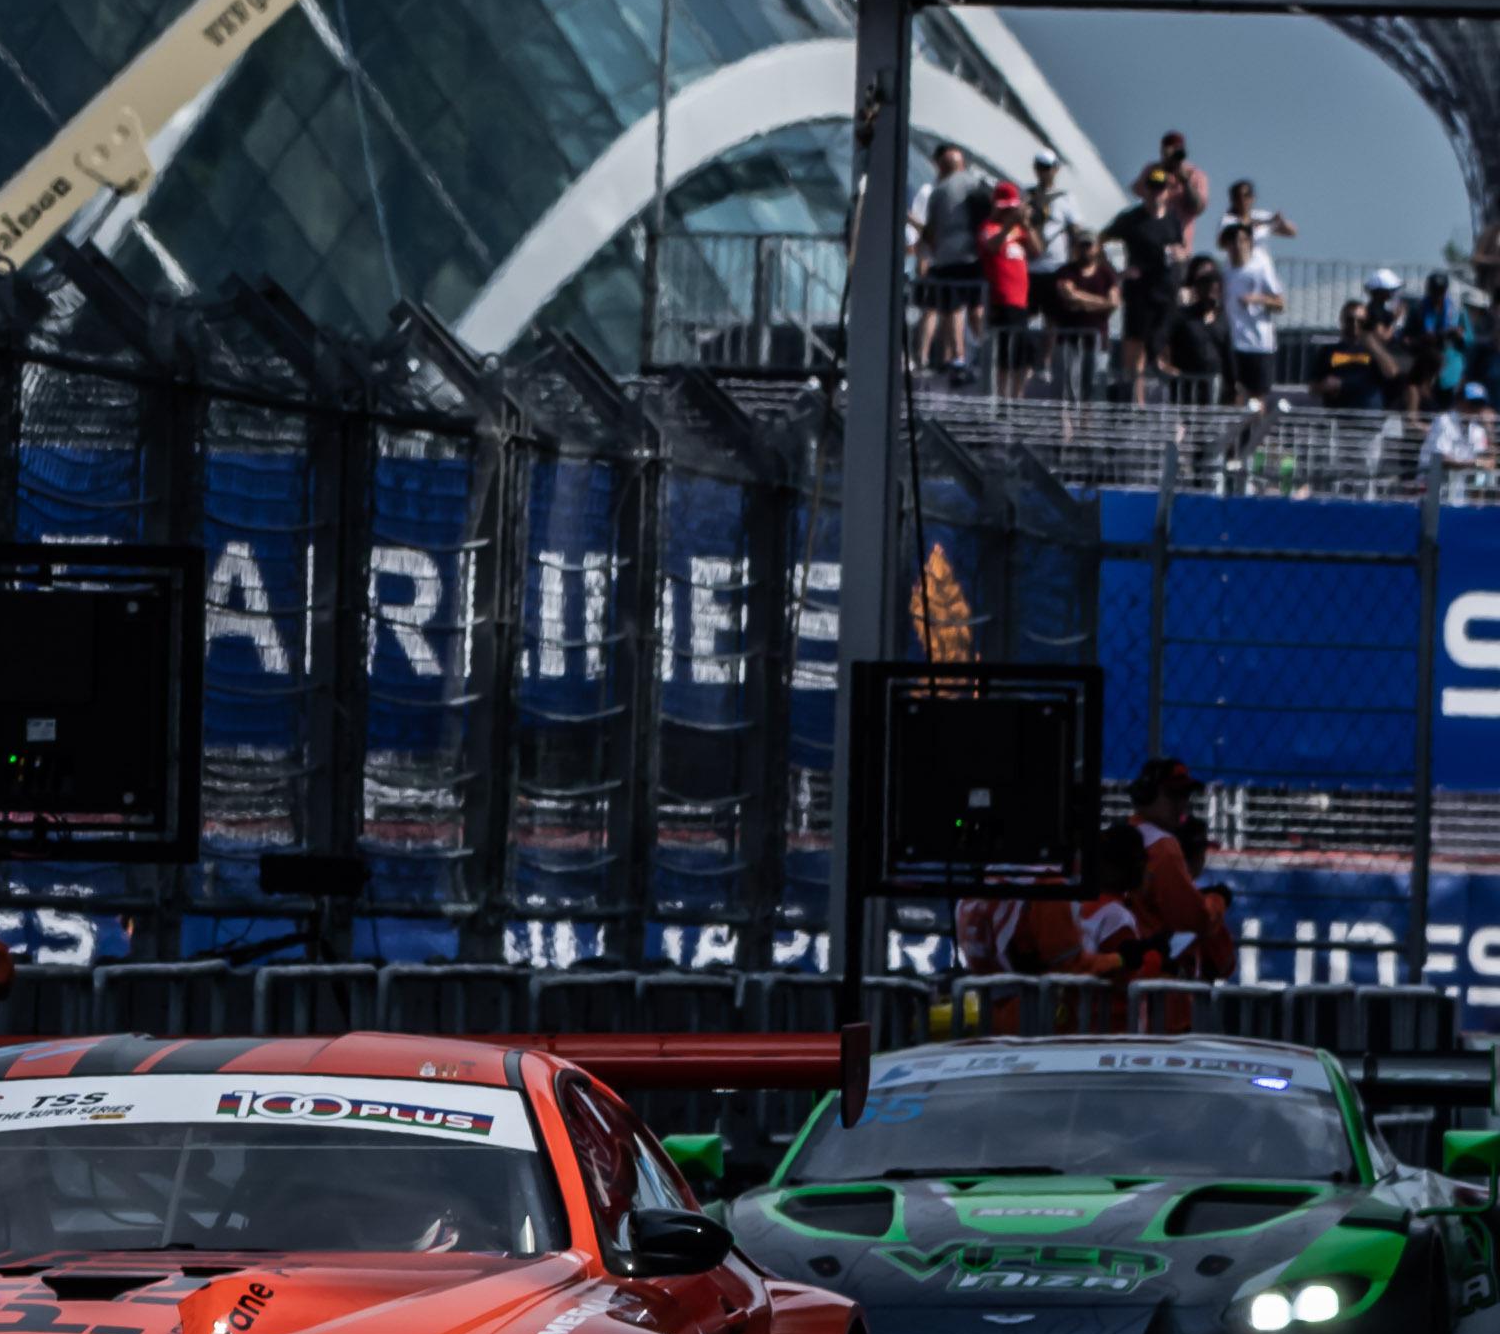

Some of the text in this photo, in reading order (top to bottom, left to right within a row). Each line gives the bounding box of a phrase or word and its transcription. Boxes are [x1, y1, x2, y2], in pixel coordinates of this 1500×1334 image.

[25, 1106, 76, 1119] SUPER
[77, 1103, 136, 1116] SERIES
[31, 1090, 474, 1130] TSS 100 PLUS
